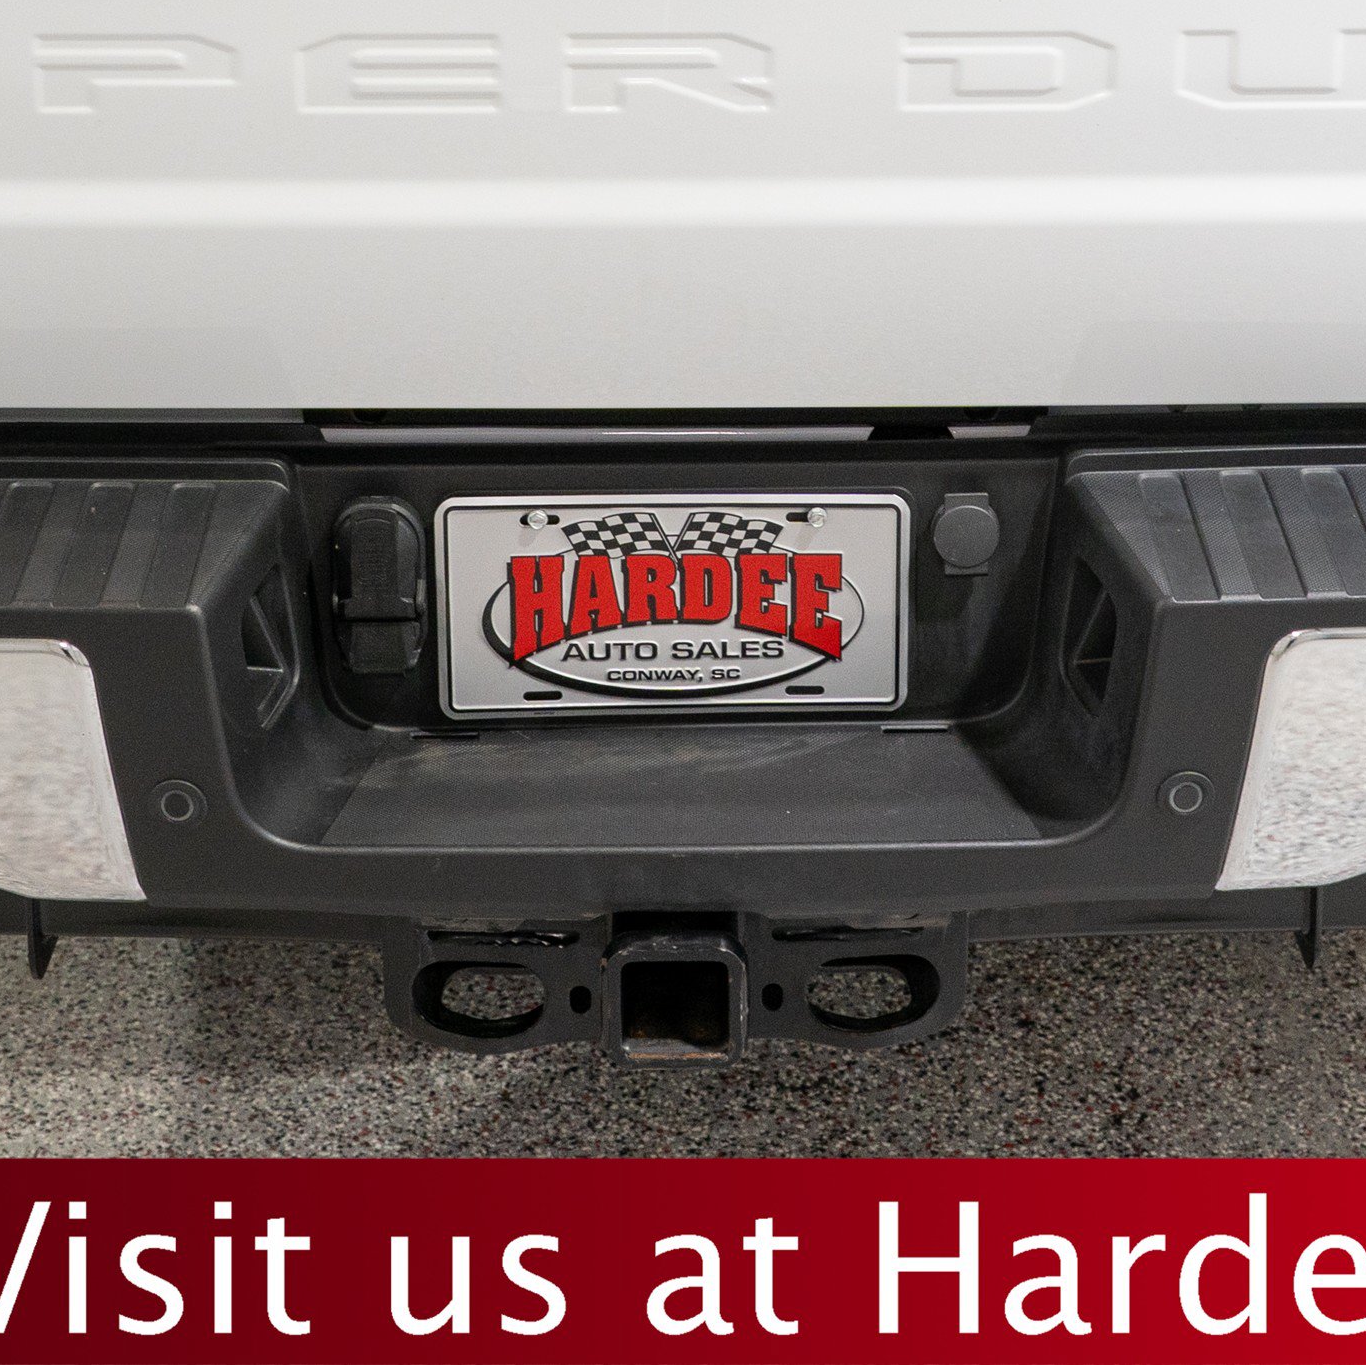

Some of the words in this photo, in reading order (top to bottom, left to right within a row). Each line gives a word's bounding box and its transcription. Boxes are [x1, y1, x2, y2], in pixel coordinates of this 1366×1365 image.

[507, 552, 844, 666] HARDEE
[561, 640, 659, 663] AUTO
[671, 639, 785, 661] SALES
[606, 668, 704, 683] CONWAY,
[711, 667, 741, 681] SC
